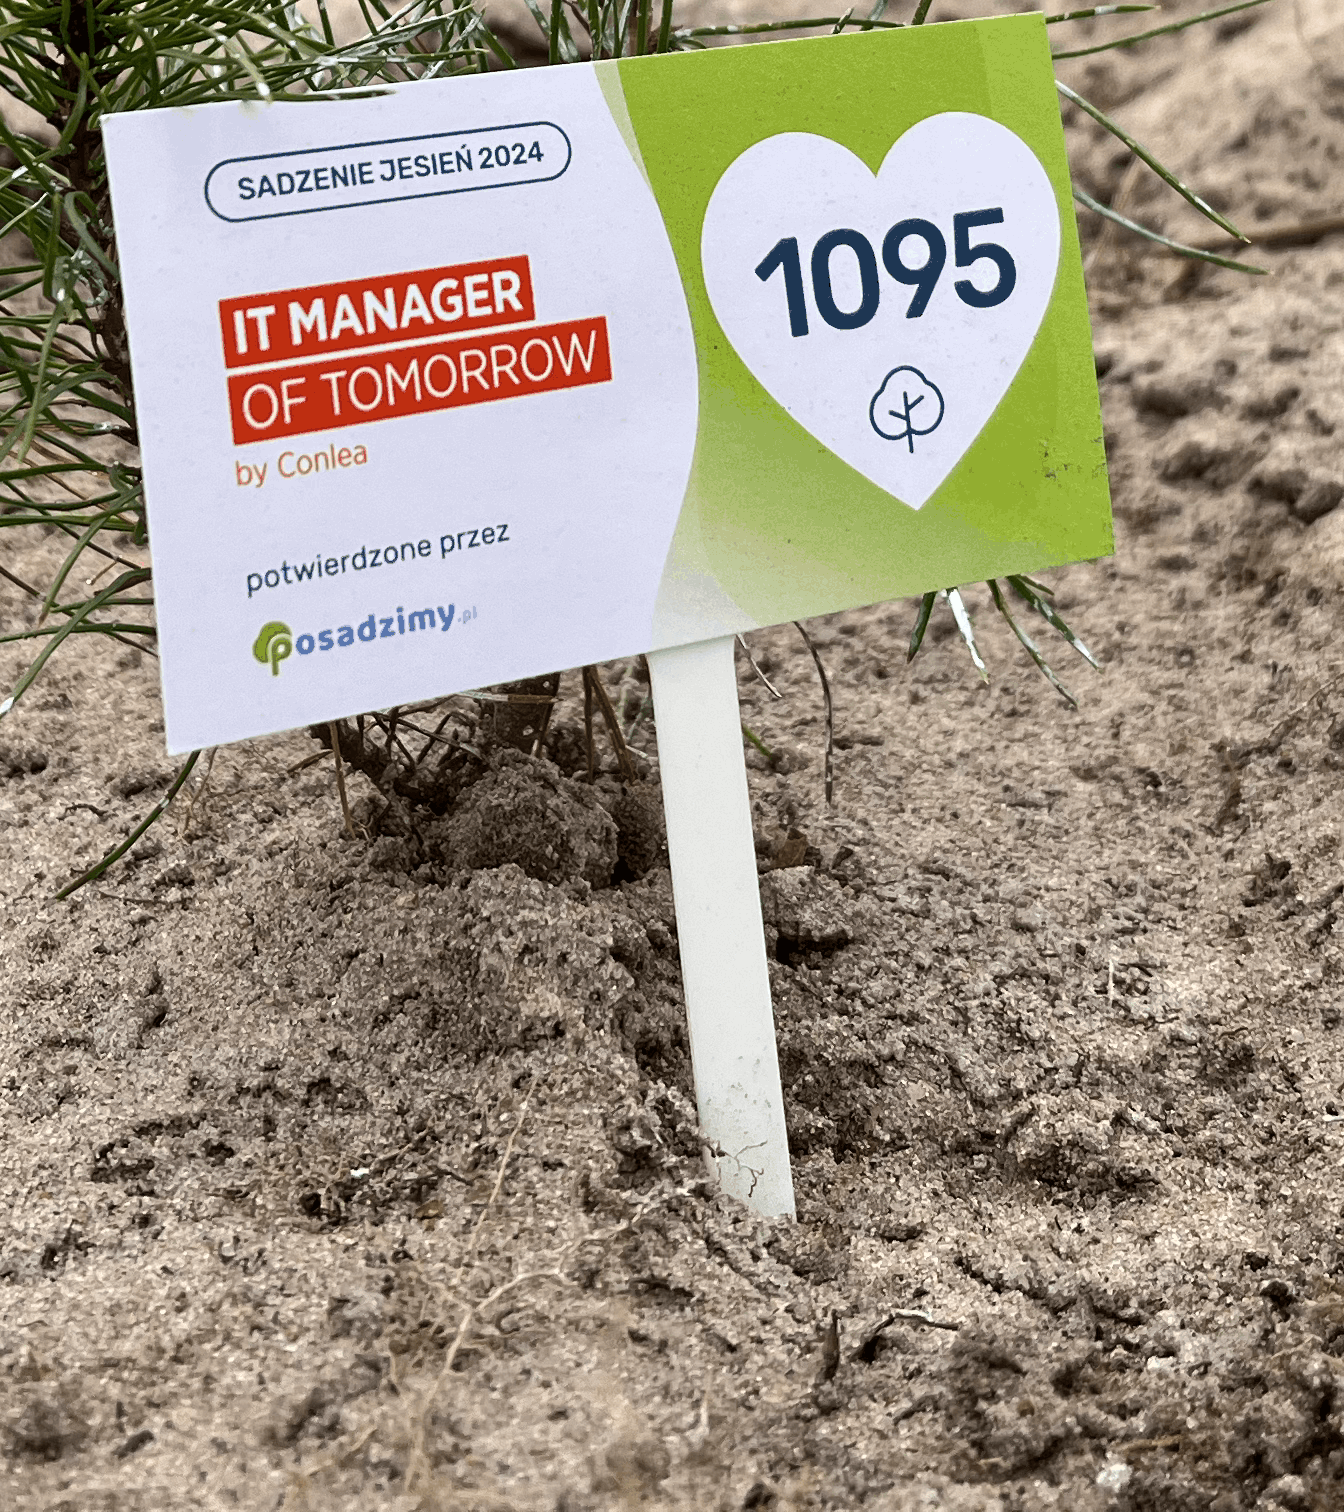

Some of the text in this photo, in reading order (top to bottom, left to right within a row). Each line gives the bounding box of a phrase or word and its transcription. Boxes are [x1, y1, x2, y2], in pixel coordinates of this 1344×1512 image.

[237, 141, 544, 200] SADZENIE JESIEŃ 2024
[755, 207, 1016, 337] 1095
[232, 270, 524, 354] IT MANAGER
[242, 330, 597, 429] OF TOMORROW
[235, 444, 368, 488] by Conlea
[246, 523, 510, 597] potwierdzone przez
